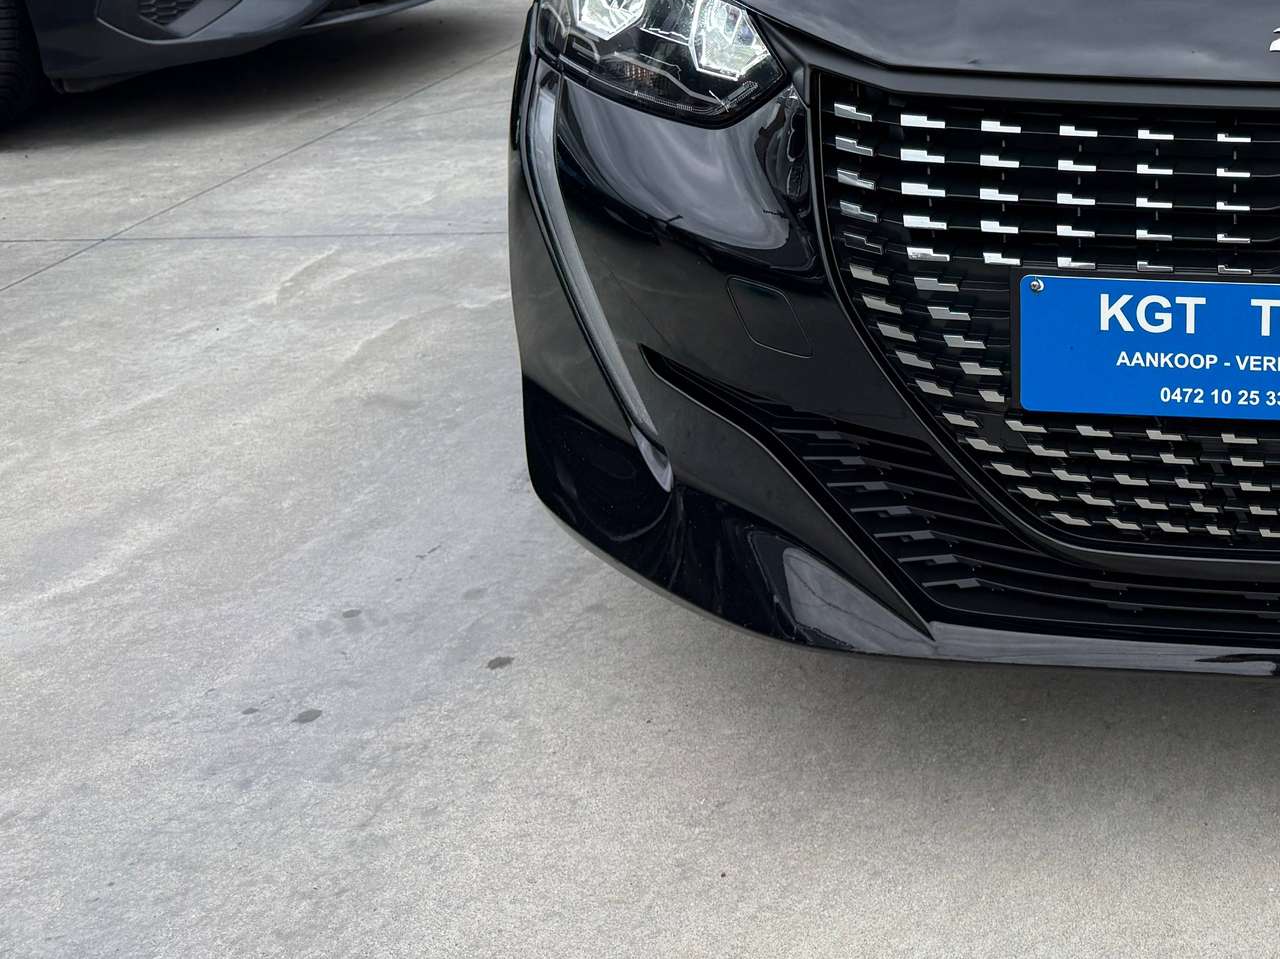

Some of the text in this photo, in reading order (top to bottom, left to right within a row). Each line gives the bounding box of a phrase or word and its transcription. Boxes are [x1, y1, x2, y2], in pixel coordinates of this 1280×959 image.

[1100, 293, 1207, 334] KGT
[1116, 351, 1218, 370] AANKOOP
[1160, 387, 1204, 404] 0472
[1210, 388, 1232, 405] 10
[1237, 389, 1260, 406] 25
